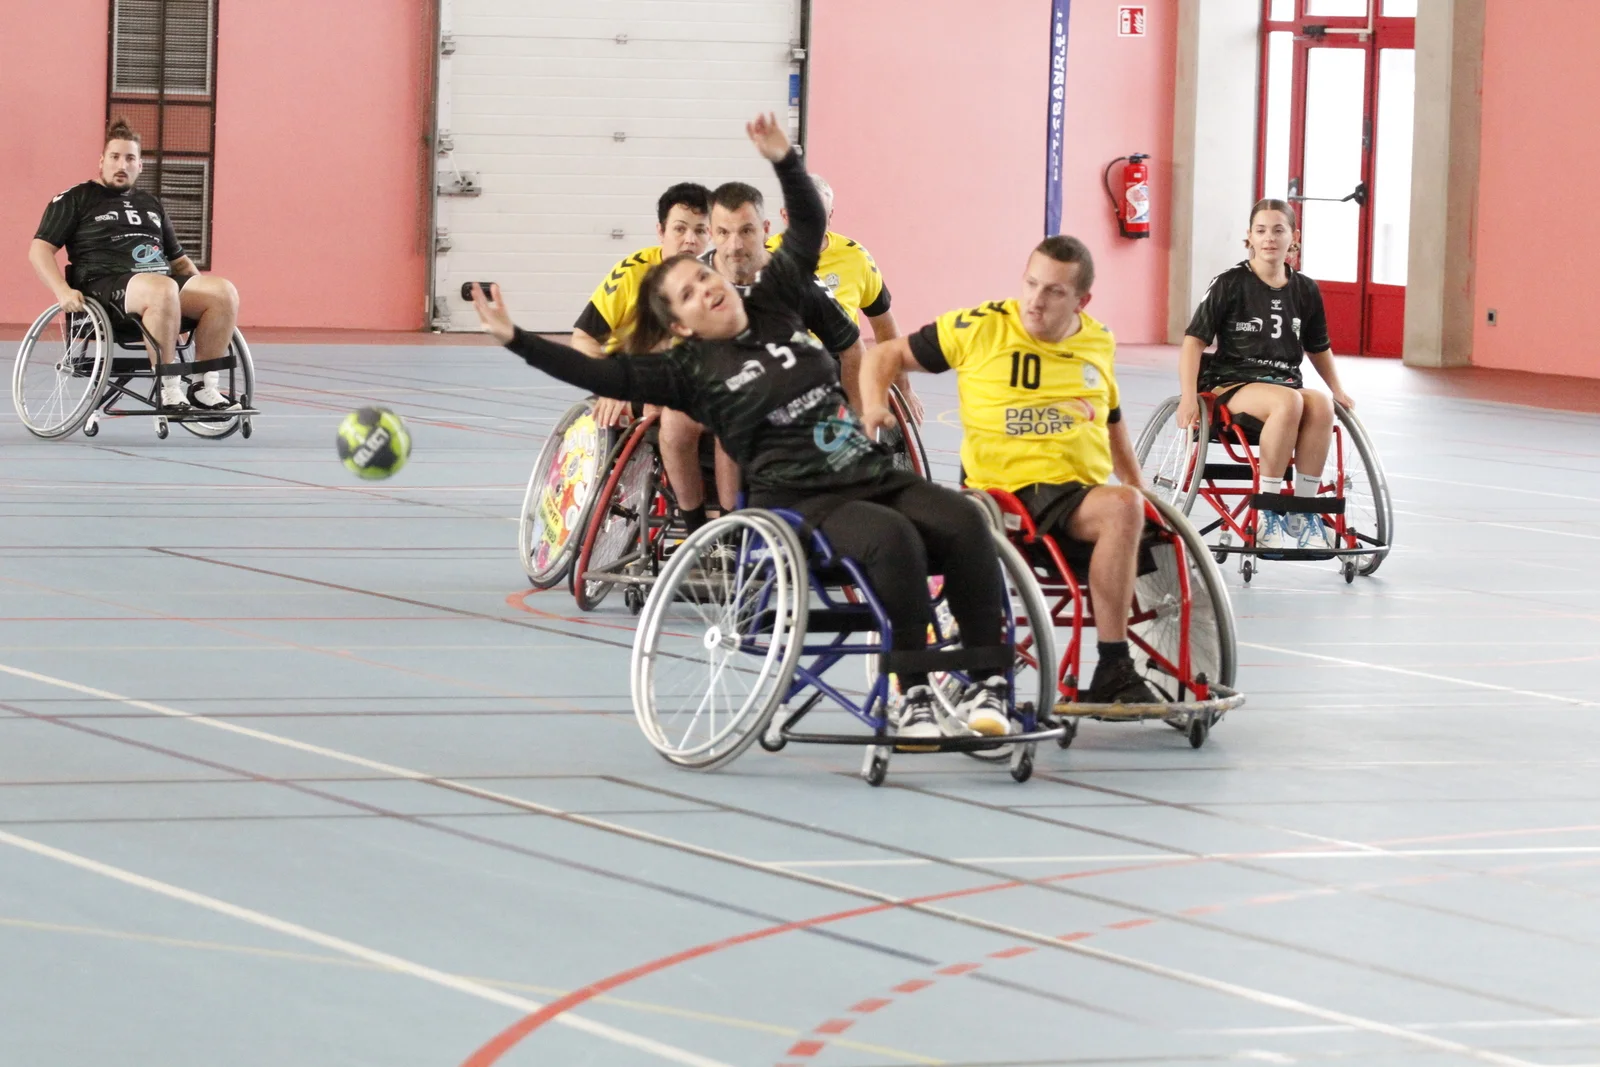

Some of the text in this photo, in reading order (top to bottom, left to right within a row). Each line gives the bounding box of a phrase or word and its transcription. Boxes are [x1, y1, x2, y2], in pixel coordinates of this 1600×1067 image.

[1270, 314, 1283, 339] 3
[765, 343, 797, 369] 5
[1010, 351, 1041, 390] 10
[1005, 407, 1060, 421] PAYS
[1005, 421, 1074, 436] SPORT
